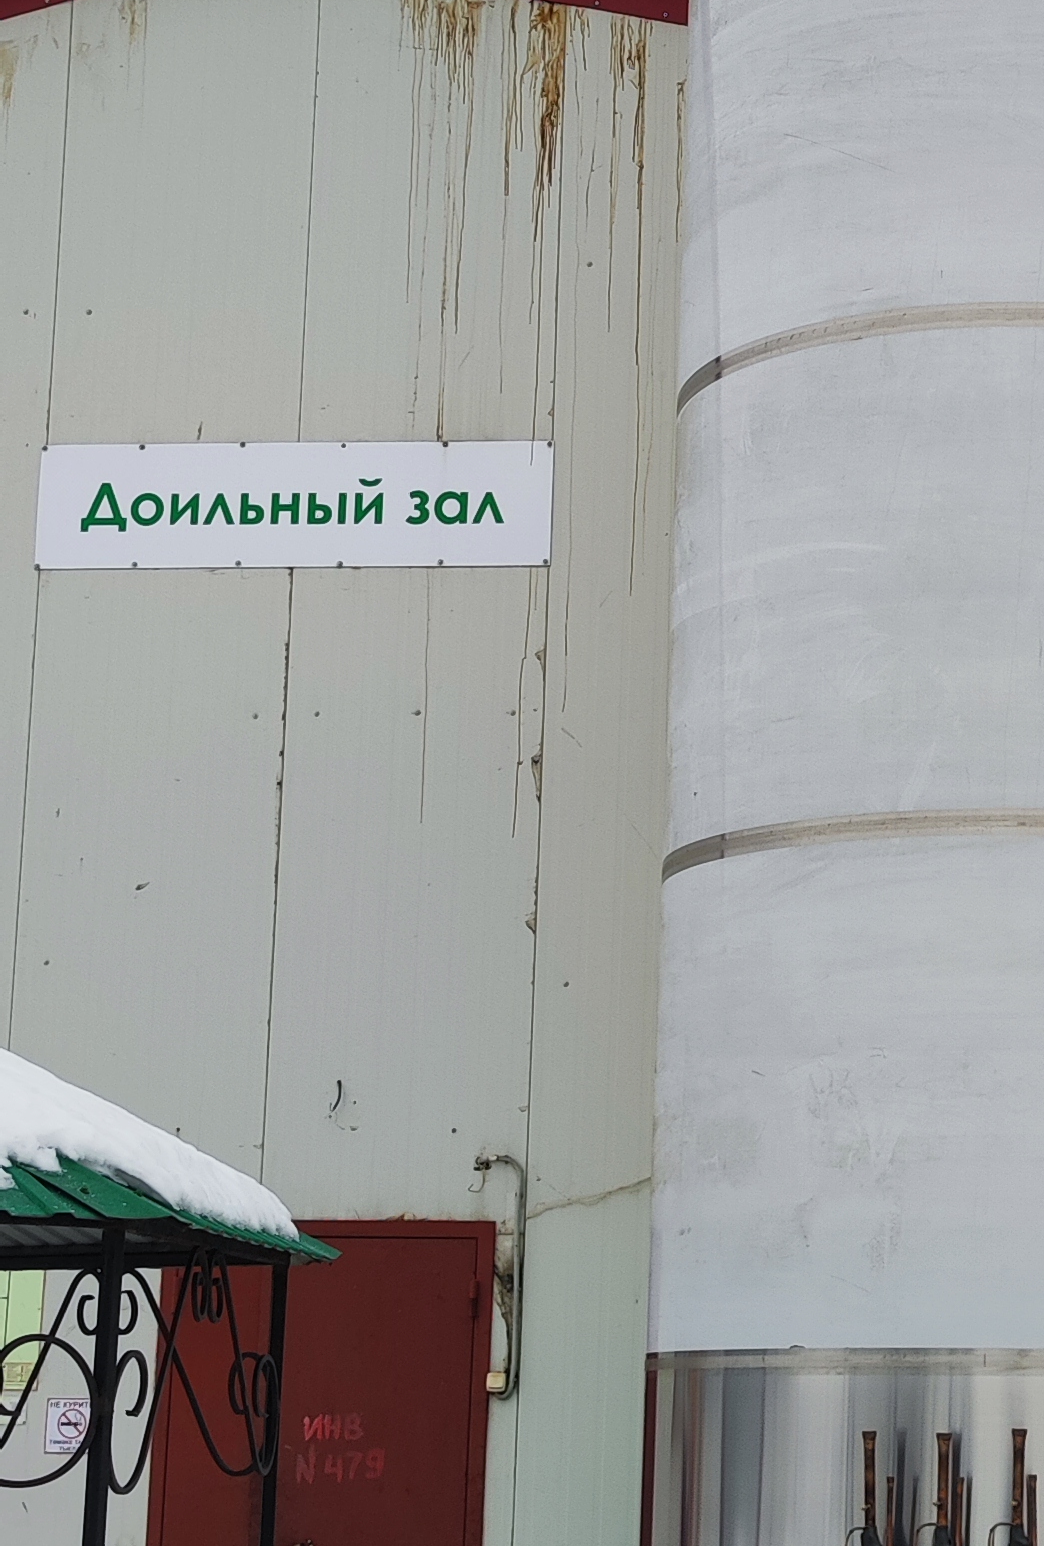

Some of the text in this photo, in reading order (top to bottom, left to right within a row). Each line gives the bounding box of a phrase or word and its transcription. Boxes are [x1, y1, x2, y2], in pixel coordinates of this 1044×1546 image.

[80, 478, 505, 532] Доильный зал
[303, 1413, 364, 1441] ИНВ
